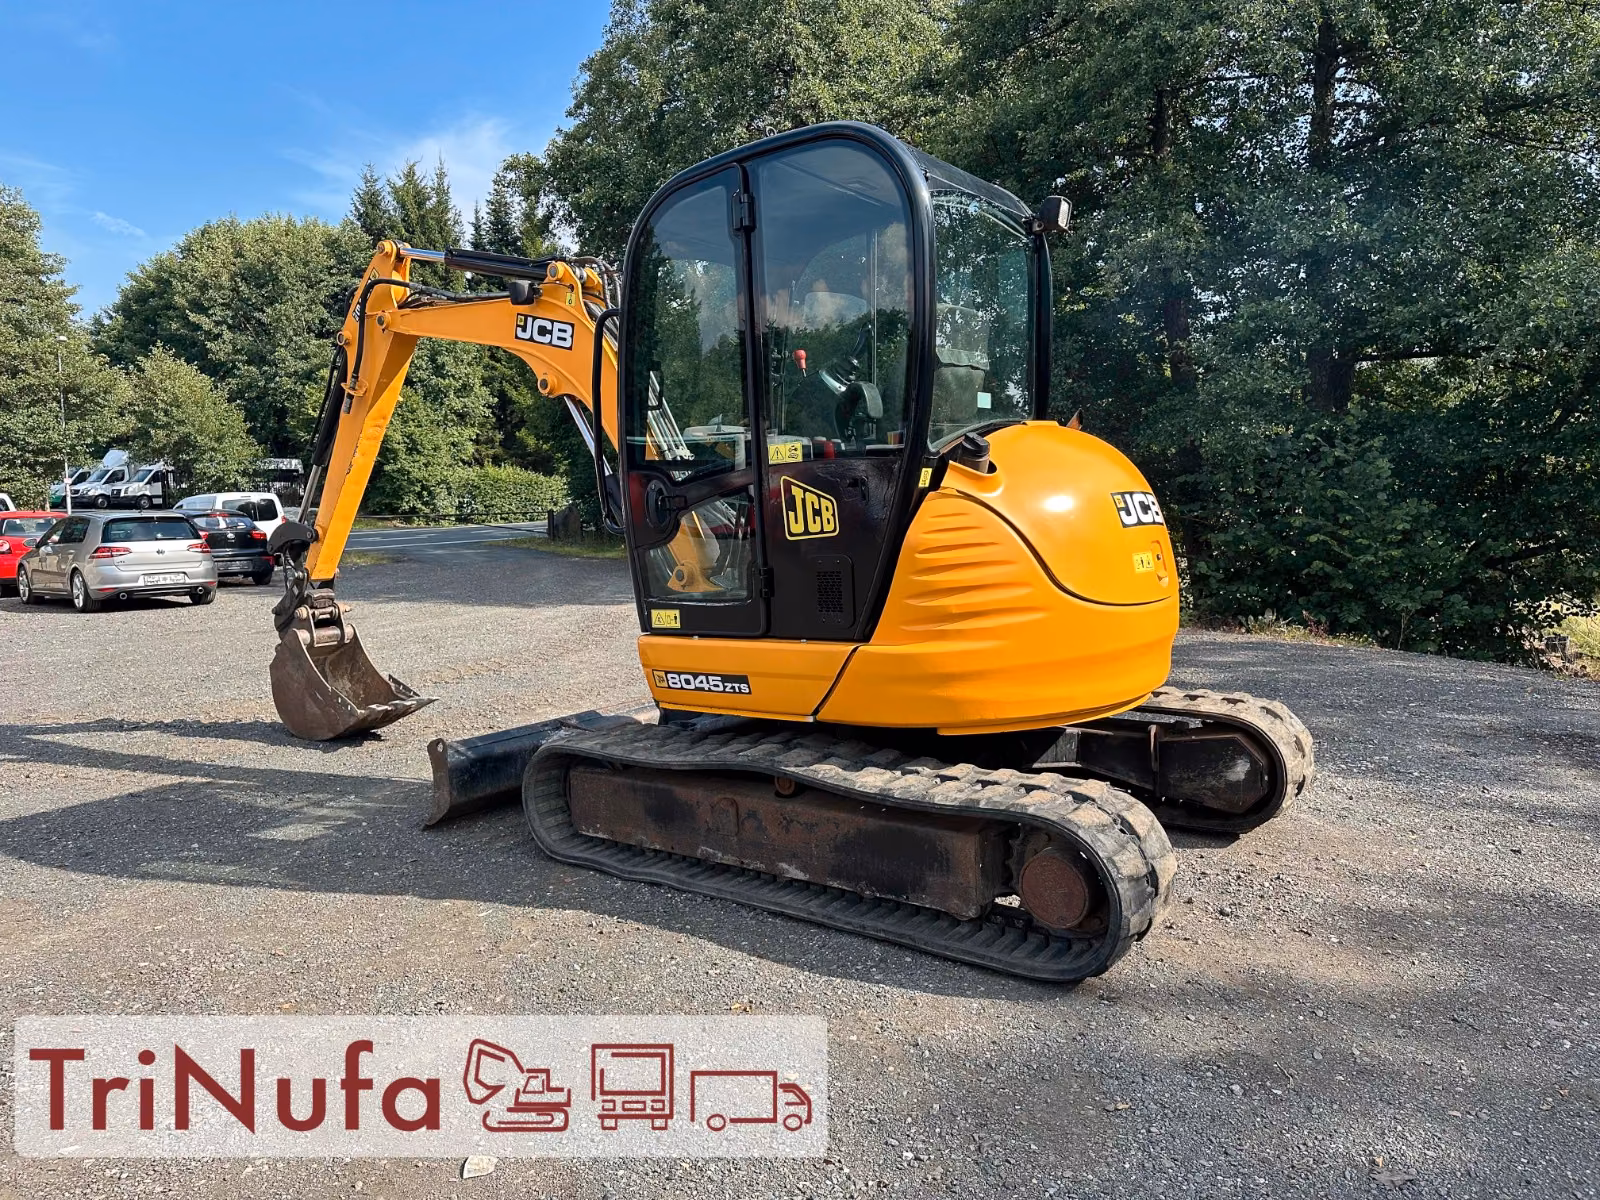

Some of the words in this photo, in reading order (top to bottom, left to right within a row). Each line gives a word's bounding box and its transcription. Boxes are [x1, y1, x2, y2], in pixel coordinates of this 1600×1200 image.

[516, 316, 573, 348] JCB
[788, 485, 835, 534] JCB
[1119, 493, 1163, 525] JCB
